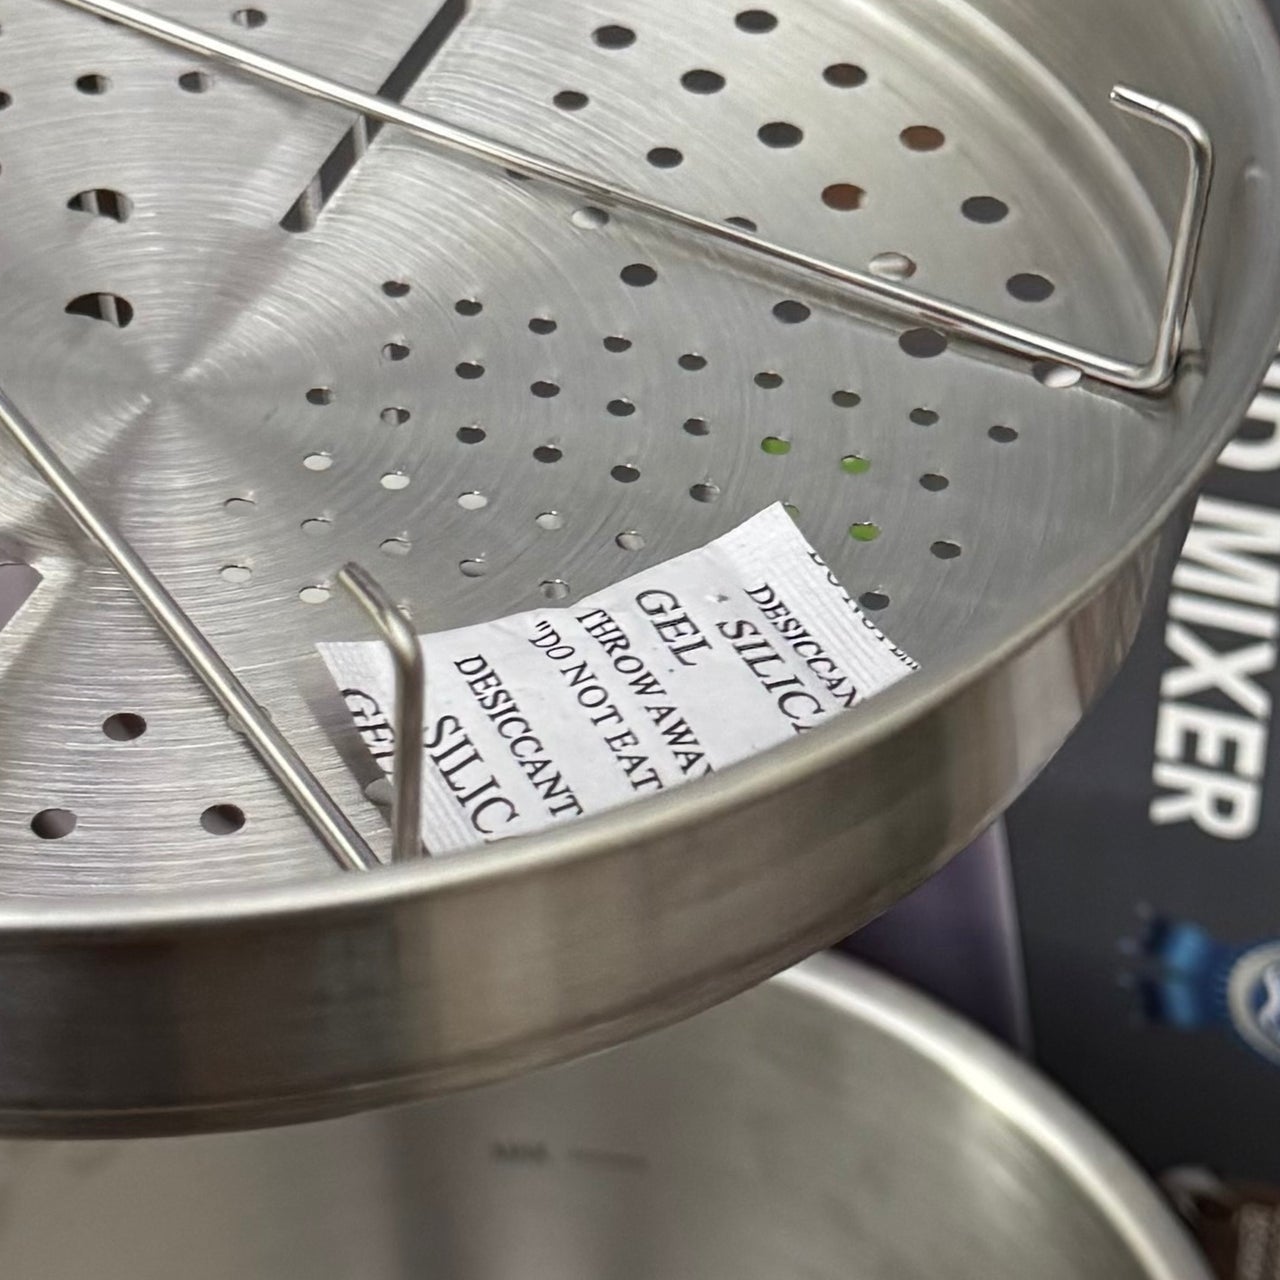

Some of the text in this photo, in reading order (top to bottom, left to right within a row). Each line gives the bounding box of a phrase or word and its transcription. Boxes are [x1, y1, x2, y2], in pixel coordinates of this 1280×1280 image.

[576, 609, 667, 696] THROW
[635, 589, 713, 666] GEL
[743, 582, 858, 709] DESICCAN
[423, 714, 520, 836] SILIC
[453, 653, 584, 818] DESICCANT
[560, 660, 624, 727] NOT
[604, 728, 664, 791] EAT
